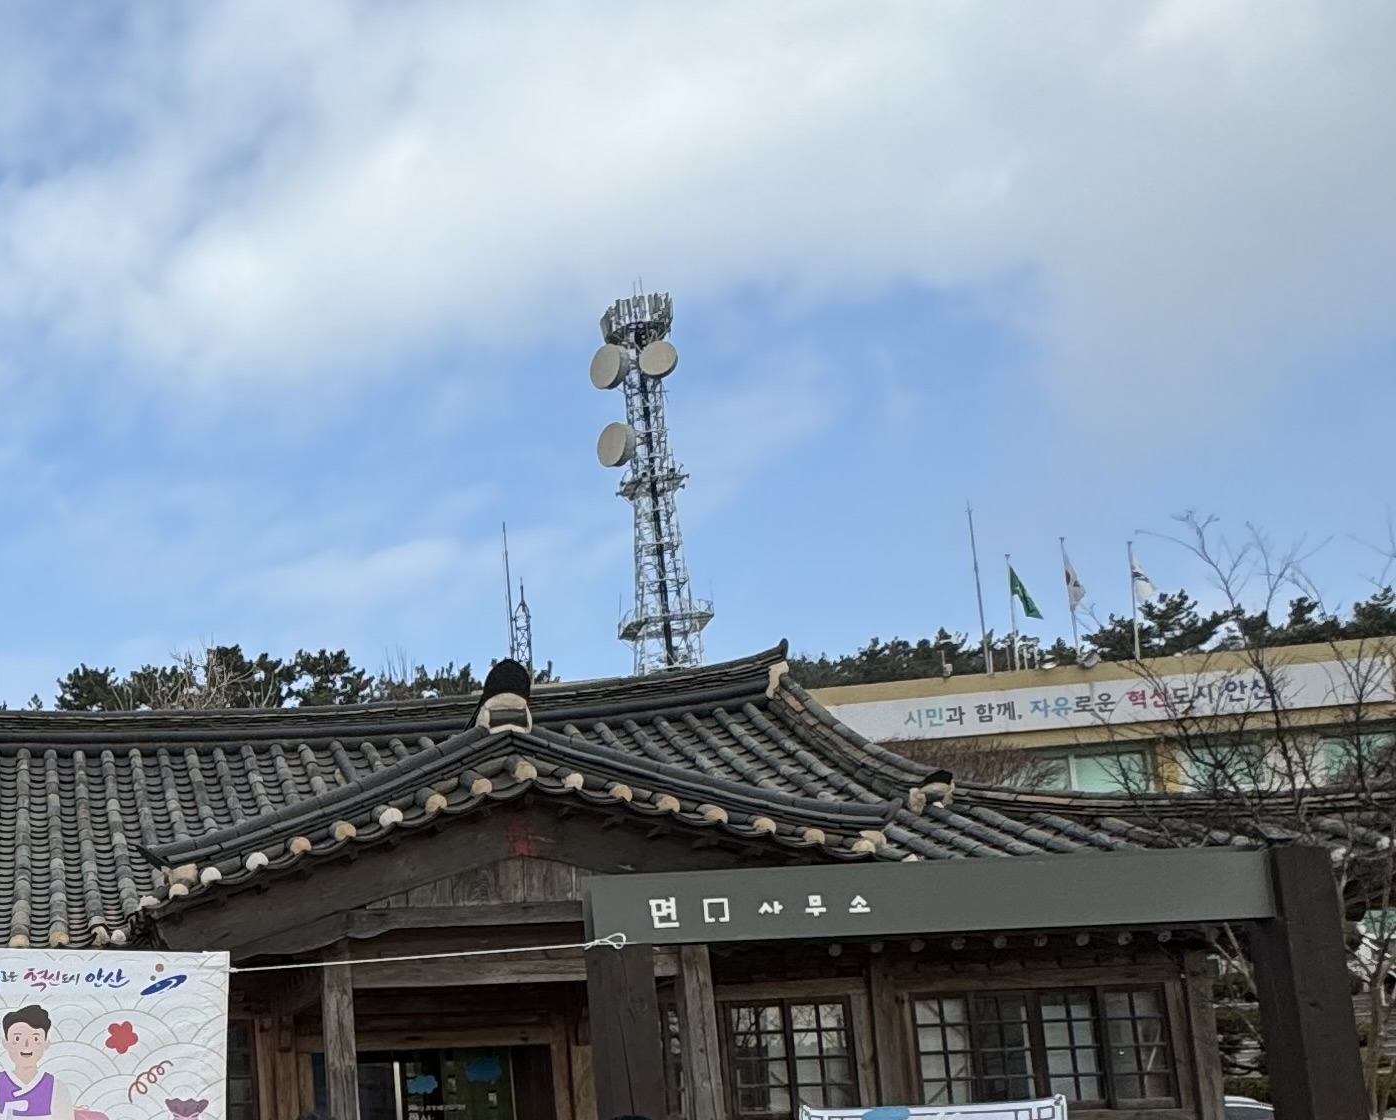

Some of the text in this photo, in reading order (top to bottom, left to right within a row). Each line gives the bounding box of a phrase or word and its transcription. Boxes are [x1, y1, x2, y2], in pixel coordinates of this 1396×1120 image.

[905, 704, 965, 729] 시민과
[974, 700, 1023, 723] 함께,
[1030, 691, 1116, 717] 자유로운
[1126, 683, 1213, 709] 혁신도시
[649, 897, 680, 929] 면
[23, 966, 80, 992] 혁신도시
[84, 967, 130, 988] 안산
